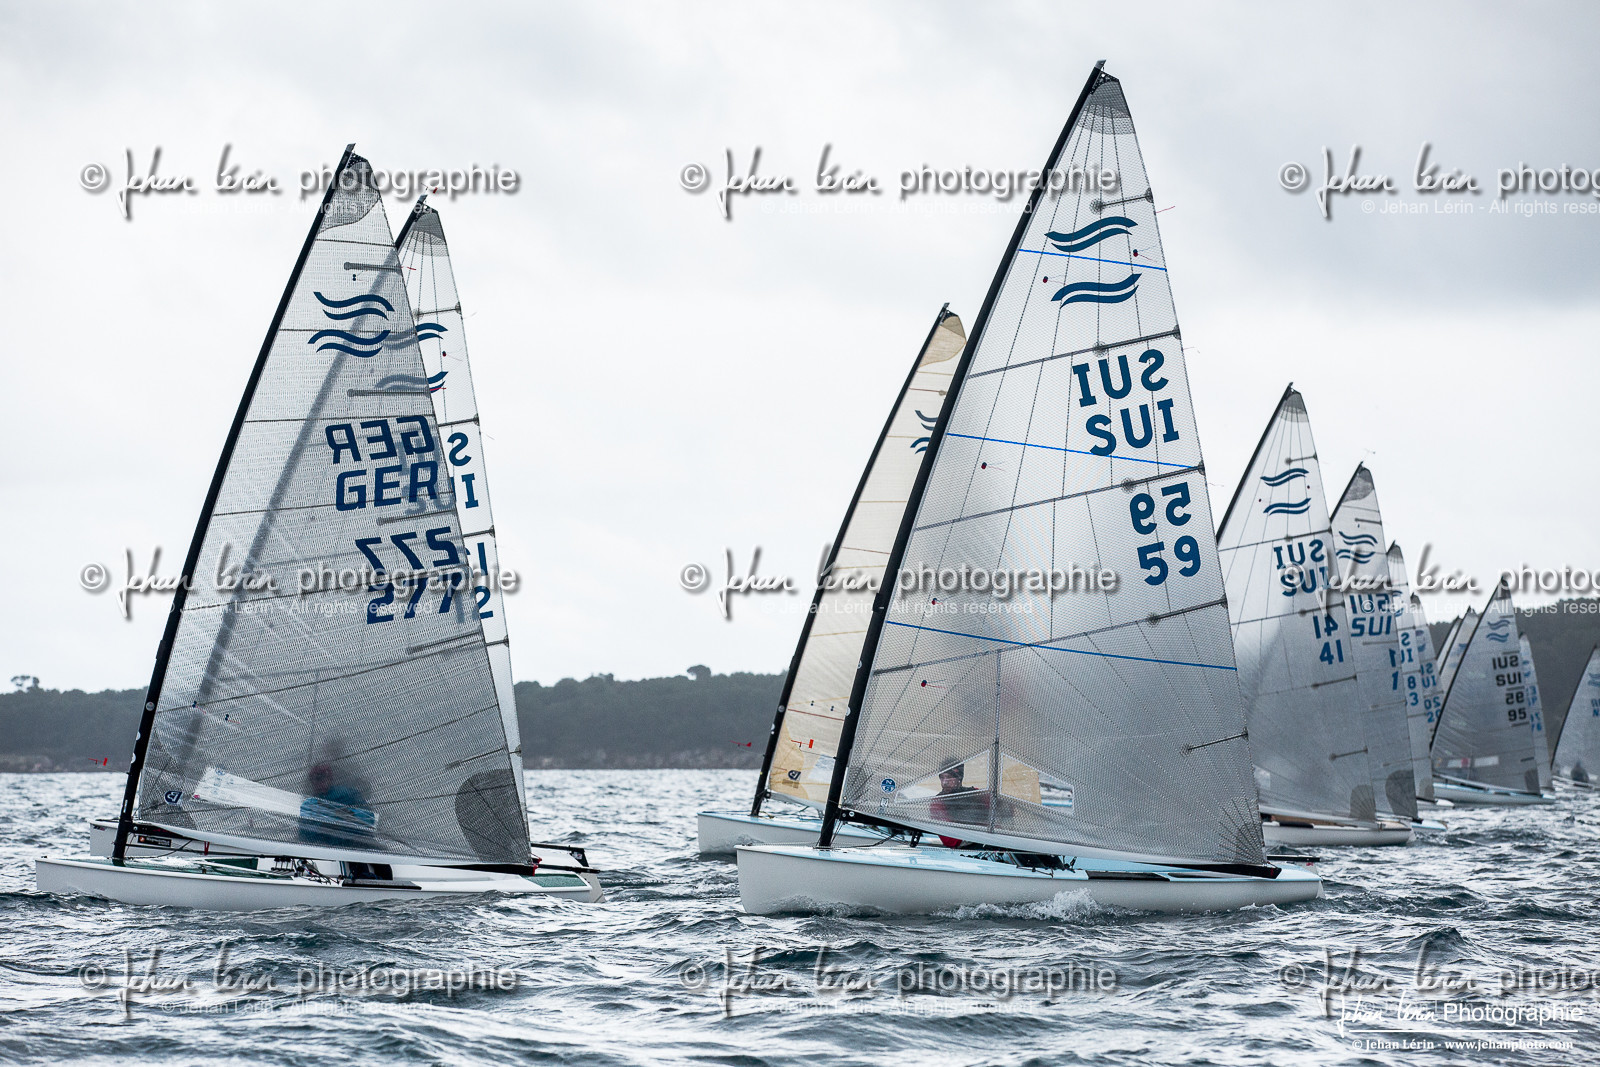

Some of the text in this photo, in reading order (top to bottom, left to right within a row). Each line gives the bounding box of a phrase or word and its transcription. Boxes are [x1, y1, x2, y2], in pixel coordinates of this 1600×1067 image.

[1085, 398, 1180, 456] SUI
[336, 460, 439, 511] GER
[1137, 535, 1201, 585] 59
[1351, 615, 1392, 637] SUI
[1320, 640, 1343, 664] 41
[1496, 672, 1522, 687] SUI
[1508, 707, 1527, 722] 95
